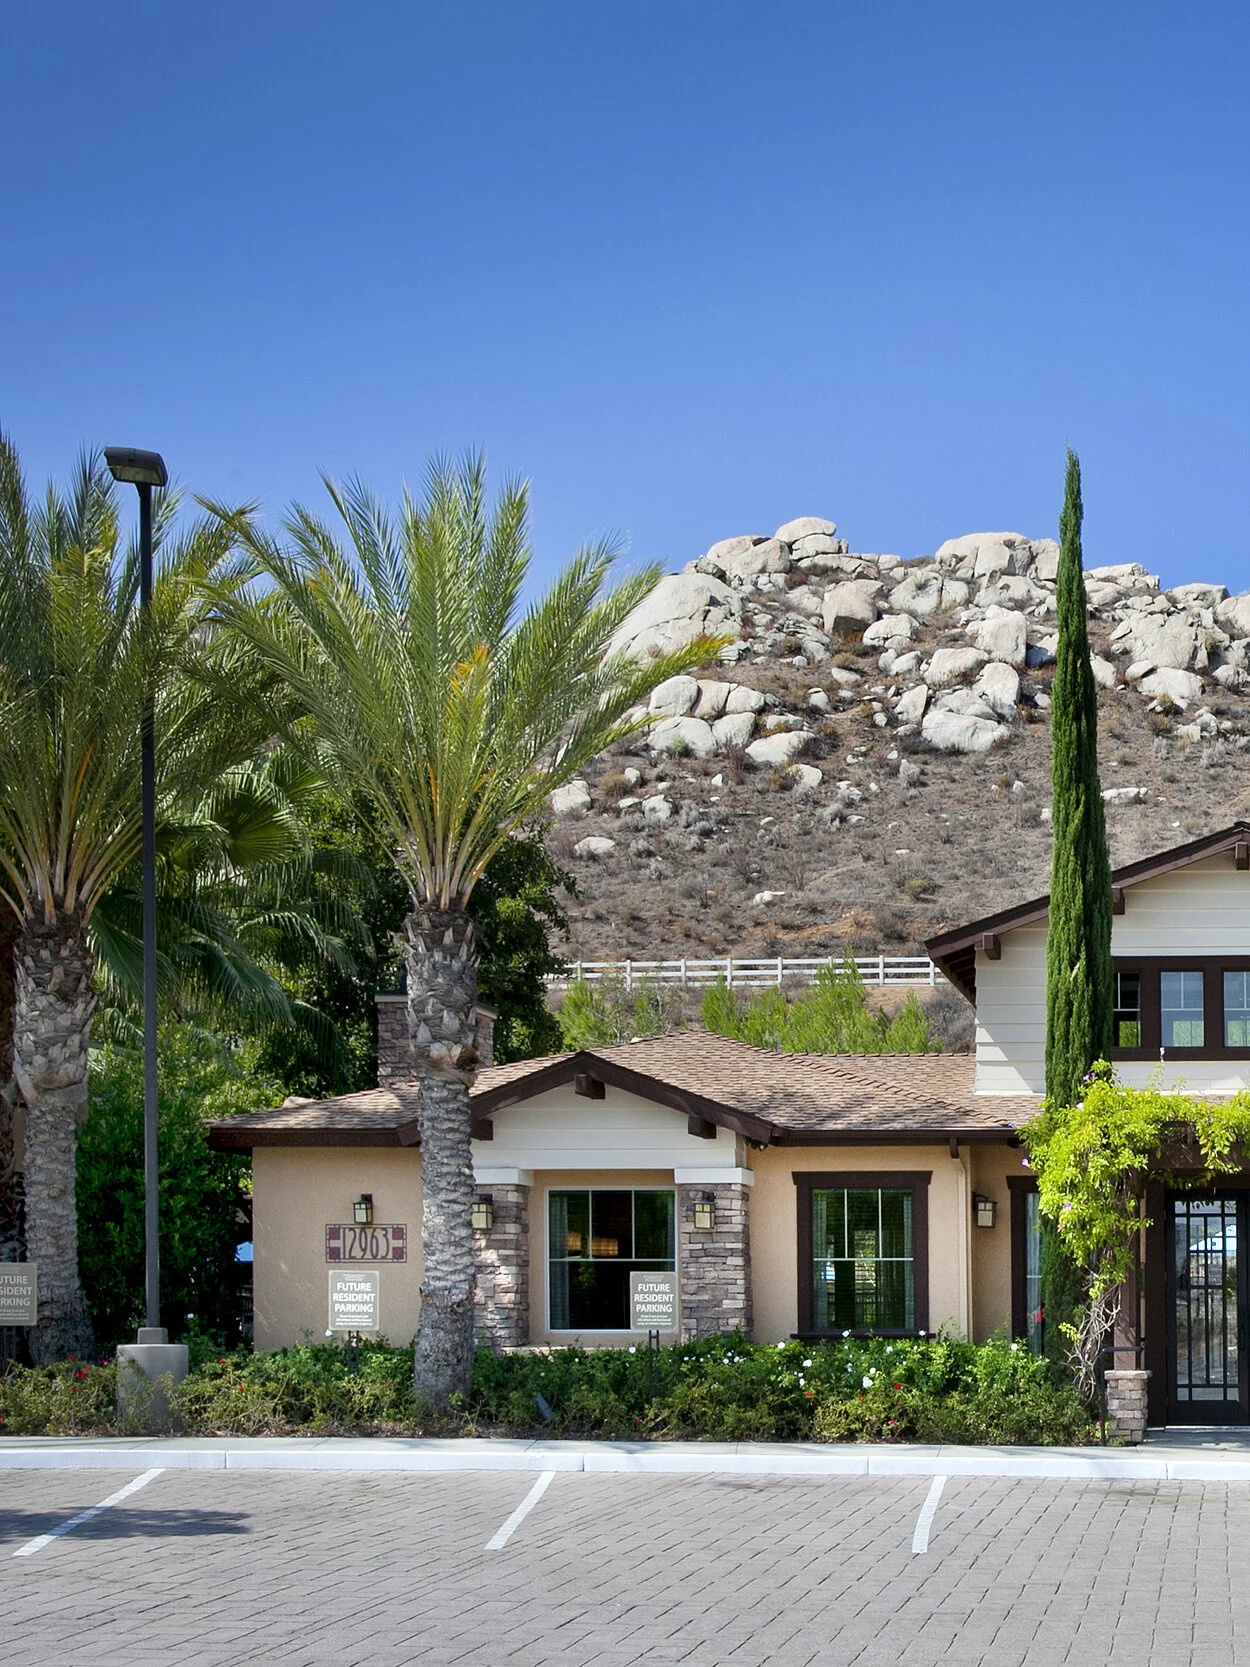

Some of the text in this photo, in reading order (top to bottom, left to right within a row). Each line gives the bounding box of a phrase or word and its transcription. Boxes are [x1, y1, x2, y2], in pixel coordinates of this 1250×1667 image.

[342, 1227, 390, 1259] 12963
[0, 1275, 29, 1285] UTURE
[0, 1286, 33, 1296] SIDENT
[336, 1282, 372, 1291] FUTURE
[637, 1283, 671, 1292] FUTURE
[0, 1297, 31, 1307] RKING
[332, 1293, 376, 1302] RESIDENT
[634, 1293, 675, 1302] RESIDENT
[334, 1303, 374, 1313] PARKING
[636, 1304, 673, 1313] PARKING
